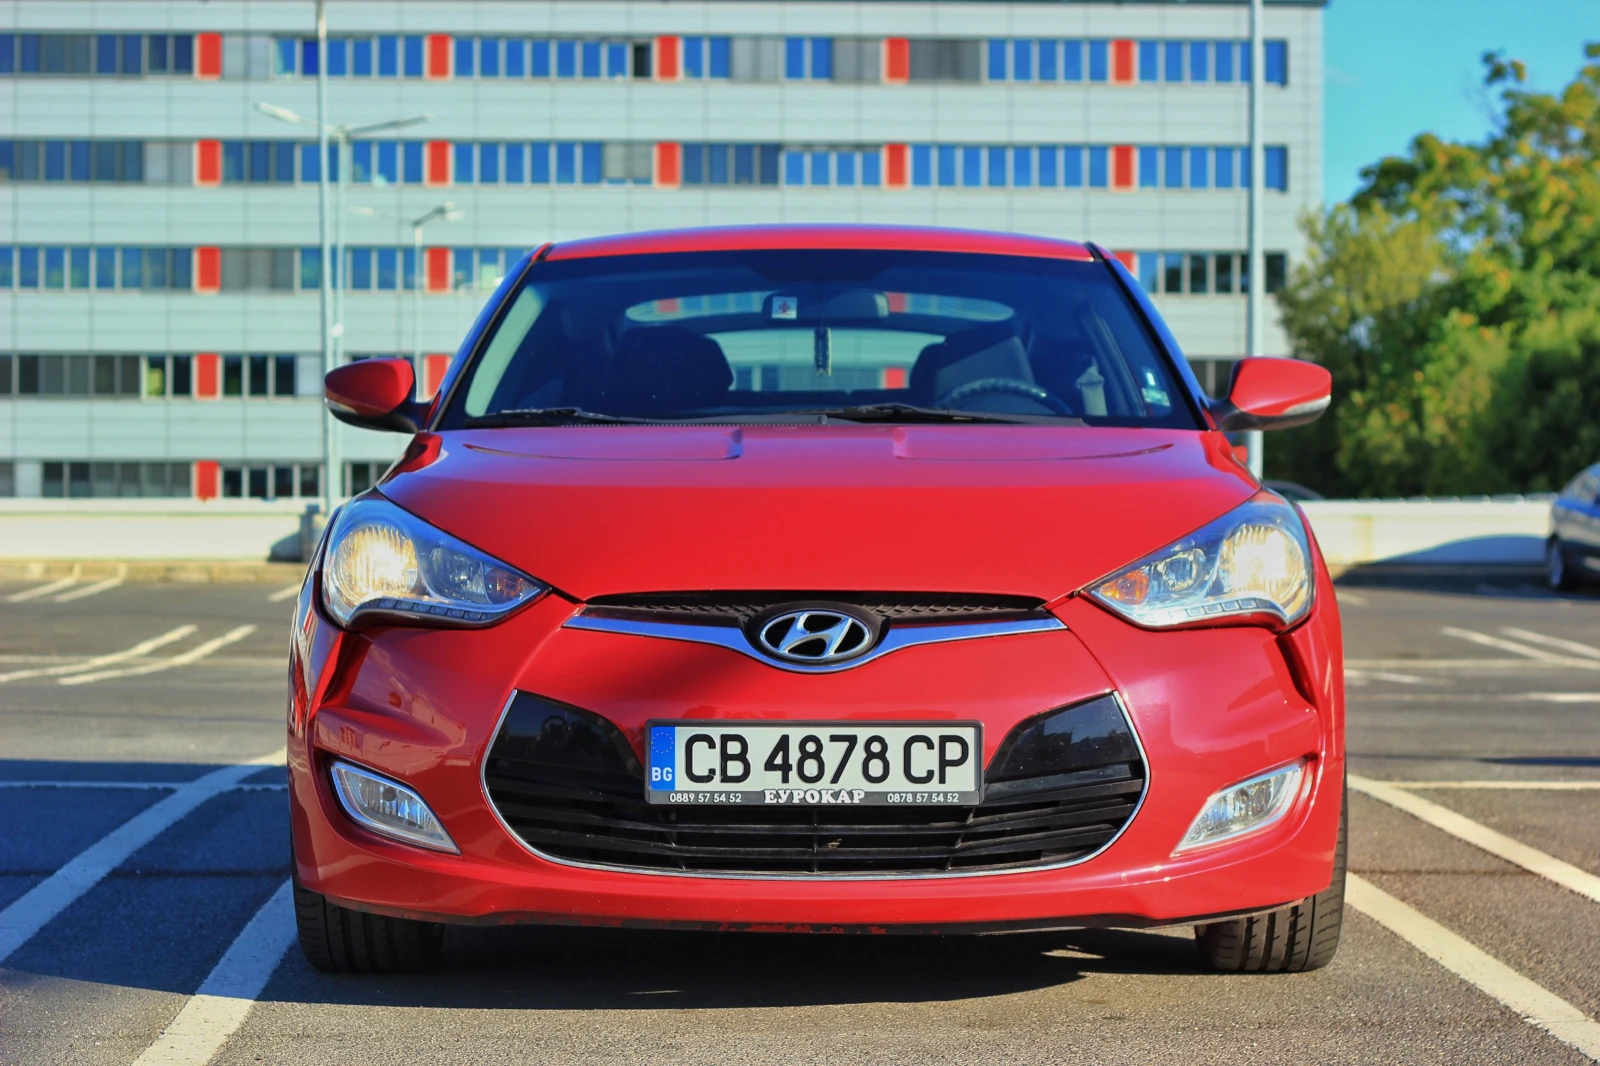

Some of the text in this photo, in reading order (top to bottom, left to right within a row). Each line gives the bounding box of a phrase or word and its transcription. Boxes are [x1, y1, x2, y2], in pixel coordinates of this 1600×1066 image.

[684, 733, 969, 785] CB 4878 CP
[651, 766, 673, 782] BG
[669, 793, 742, 803] 0889 57 54 52
[763, 788, 866, 805] ЕУРОКАР
[887, 793, 959, 803] 0878 57 54 52
